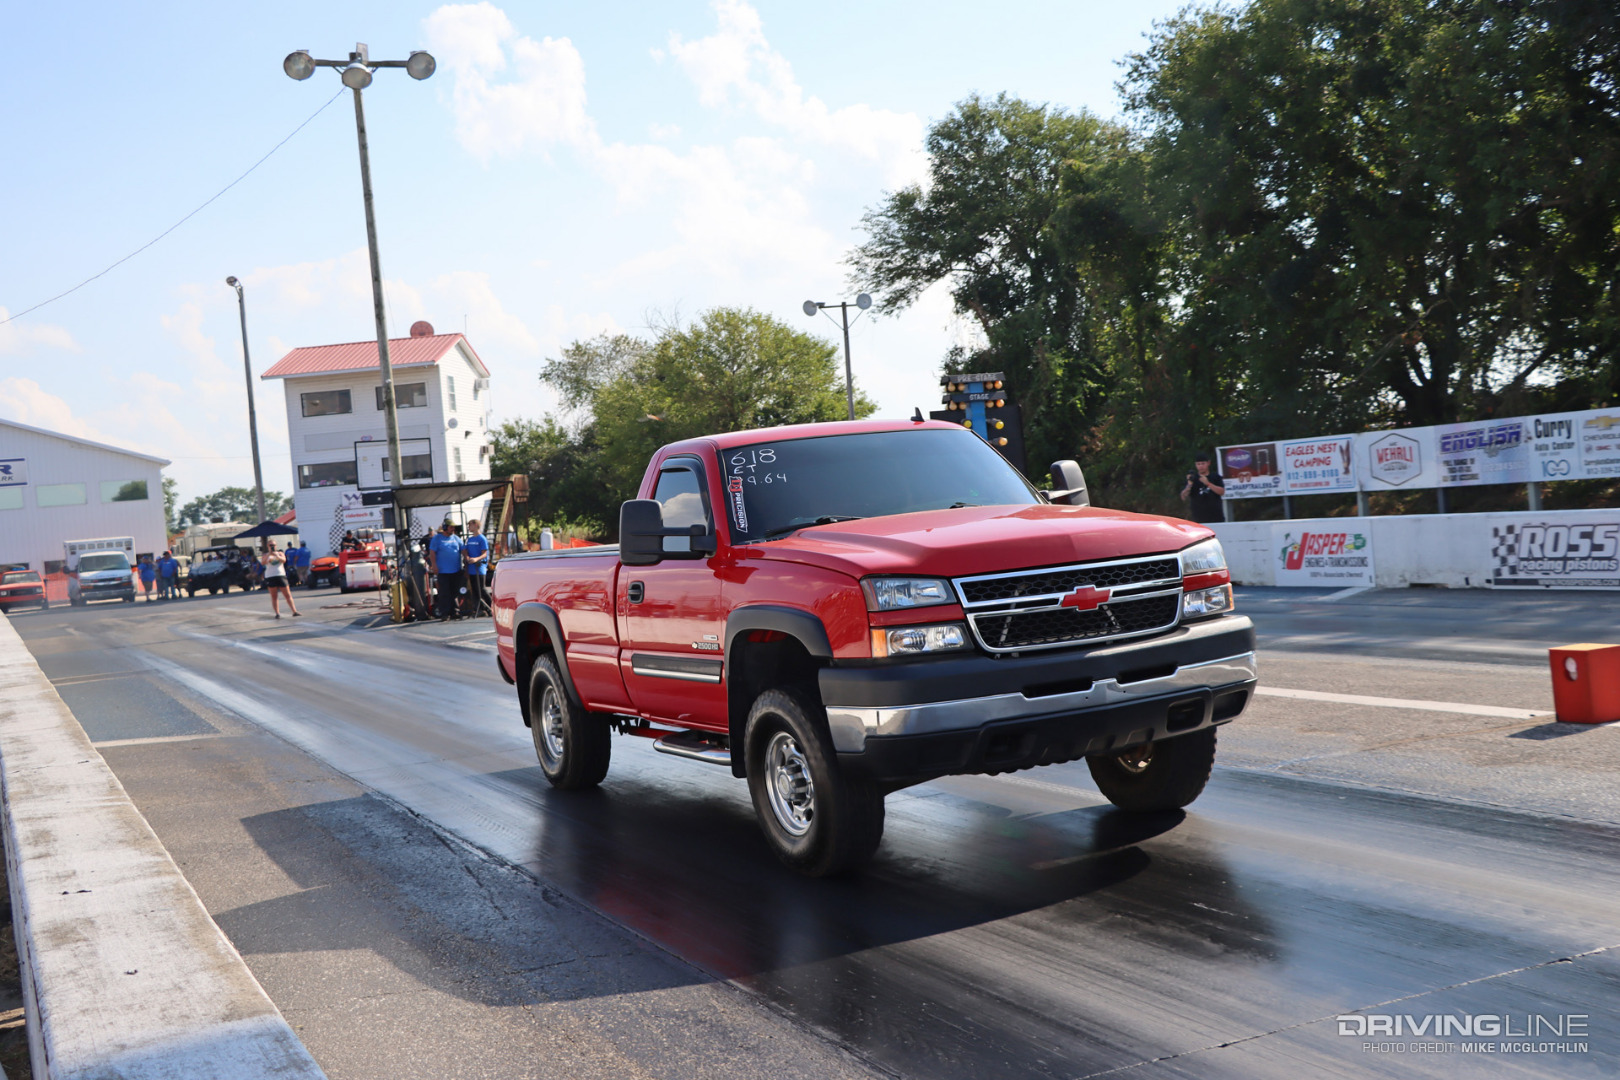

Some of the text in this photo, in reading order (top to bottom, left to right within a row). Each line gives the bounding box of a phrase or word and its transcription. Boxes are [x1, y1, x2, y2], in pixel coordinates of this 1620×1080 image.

[969, 393, 989, 401] STAGE
[1534, 418, 1572, 439] Curry
[1440, 423, 1521, 454] ENGLISH
[731, 449, 776, 465] 618
[1286, 443, 1338, 457] EAGLES NEST
[1376, 446, 1413, 464] WEHRLI
[1293, 456, 1331, 469] CAMPING
[747, 473, 787, 485] 9.64
[735, 492, 746, 528] PRECISION
[1518, 524, 1620, 559] ROSS
[1286, 532, 1347, 570] JASPER
[1519, 558, 1619, 574] racing pistons
